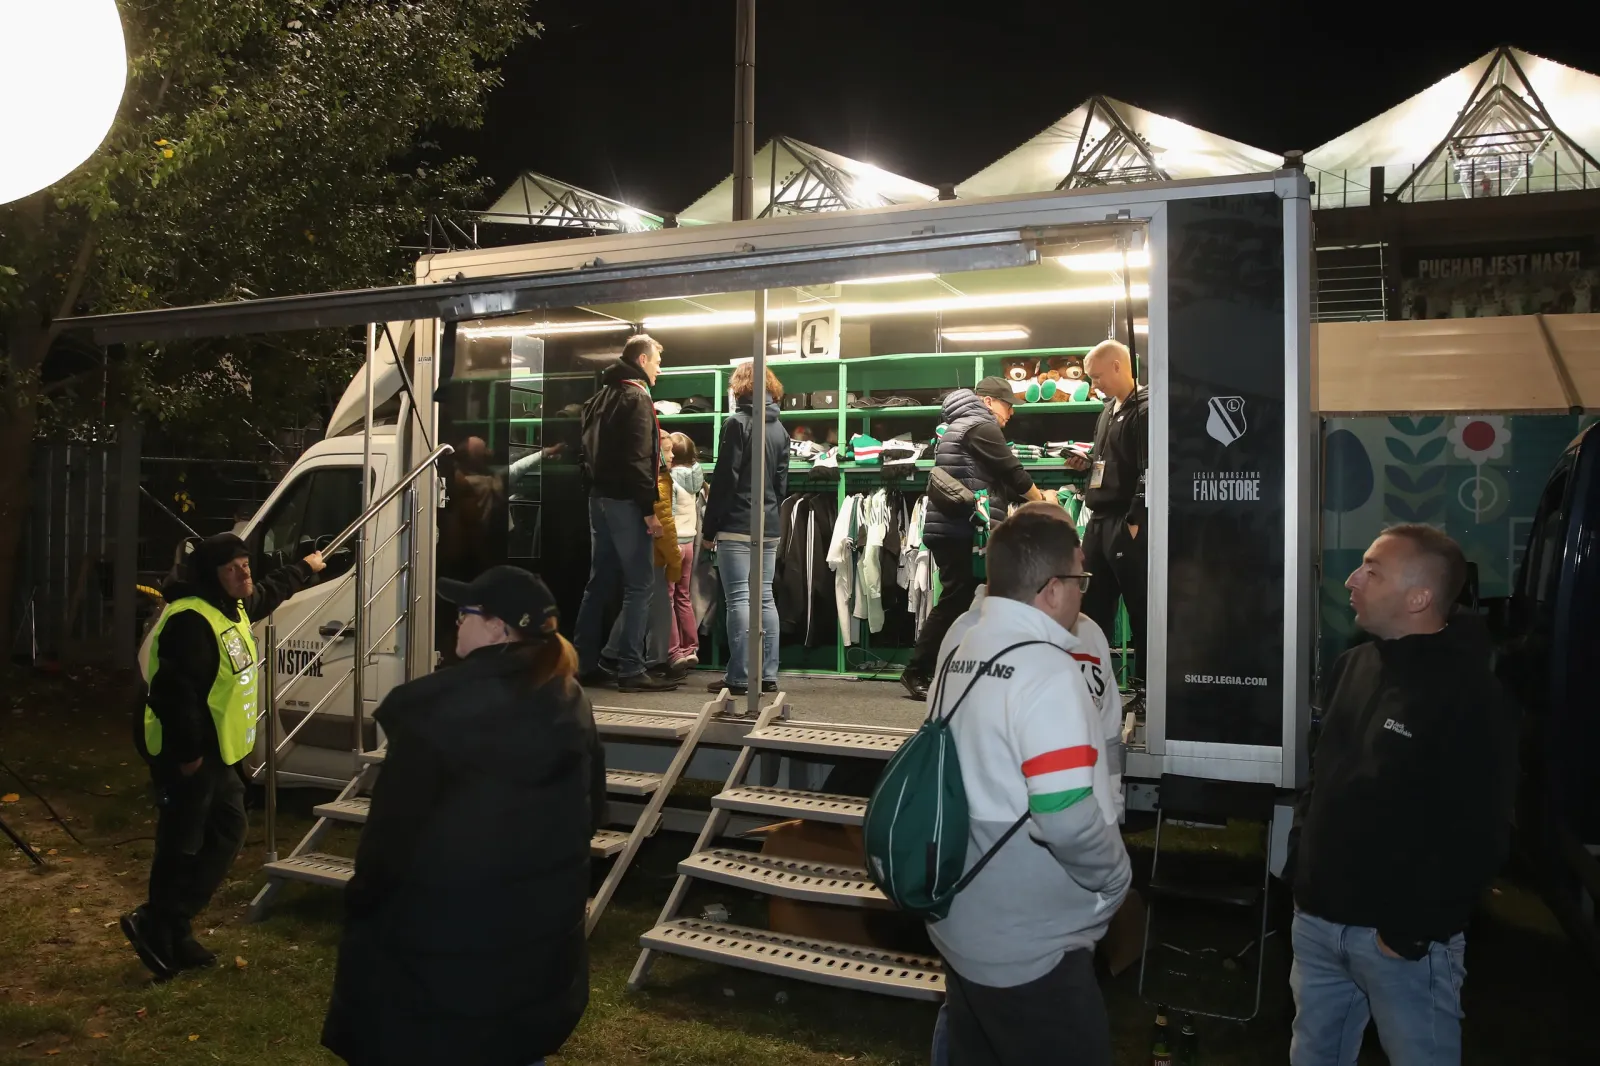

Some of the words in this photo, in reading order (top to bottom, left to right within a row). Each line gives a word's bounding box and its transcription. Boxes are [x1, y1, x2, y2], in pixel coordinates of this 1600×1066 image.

[1418, 257, 1483, 279] PUCHAR
[1486, 254, 1527, 275] JEST
[1531, 251, 1580, 274] NASZ!
[1193, 480, 1260, 501] FANSTORE
[278, 648, 323, 677] NSTORE
[1184, 674, 1268, 686] SKLEP.LEGIA.COM
